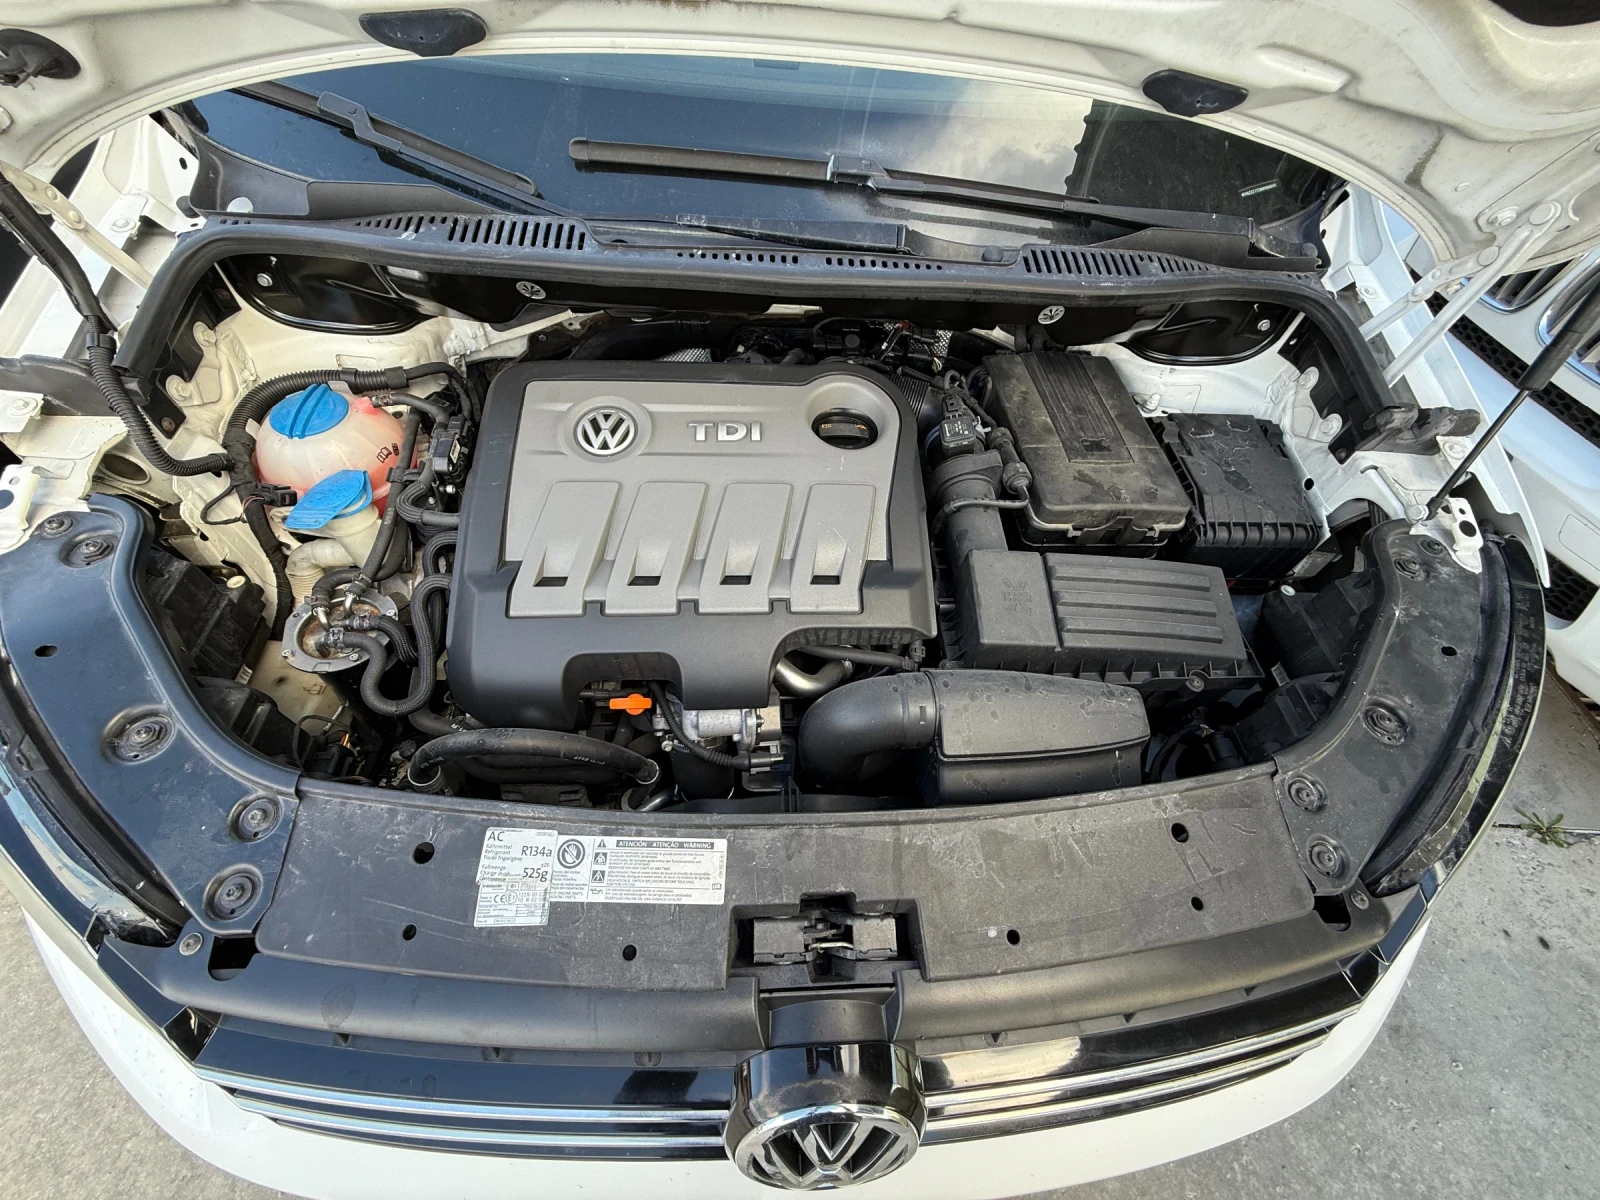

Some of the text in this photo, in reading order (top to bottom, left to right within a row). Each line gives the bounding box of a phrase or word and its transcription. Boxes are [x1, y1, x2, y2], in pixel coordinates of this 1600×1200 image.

[688, 420, 763, 442] TDI
[488, 830, 505, 842] AC
[618, 840, 648, 848] ATENCIÓN
[521, 846, 552, 857] R134a
[522, 867, 548, 882] 525g
